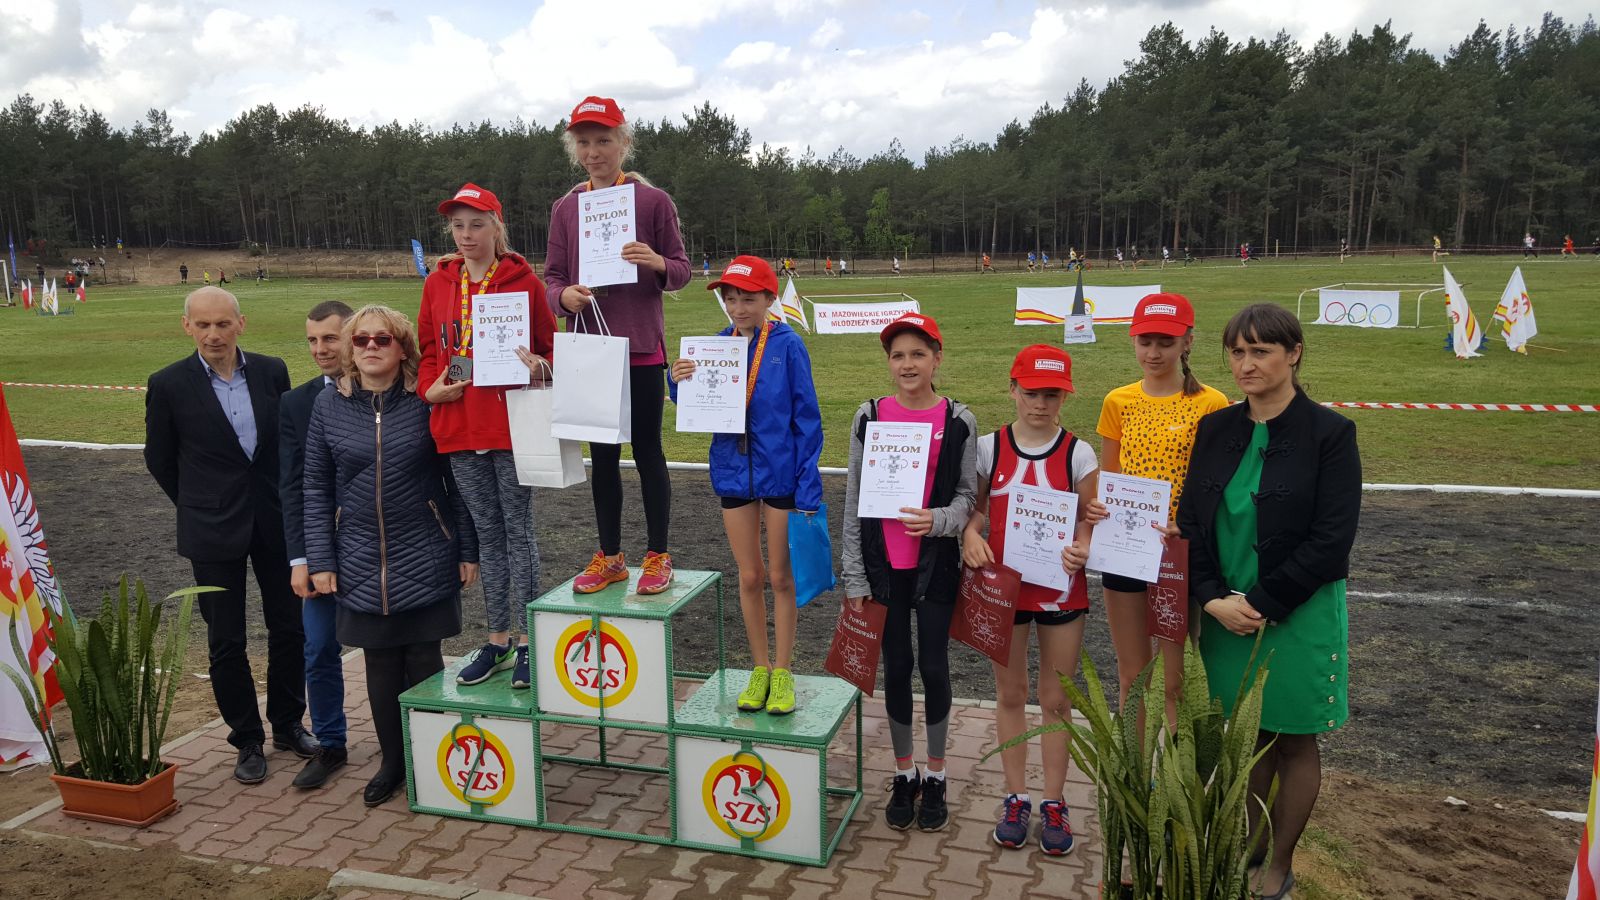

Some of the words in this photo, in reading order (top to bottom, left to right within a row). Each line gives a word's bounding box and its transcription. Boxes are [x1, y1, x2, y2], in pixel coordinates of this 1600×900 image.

[584, 209, 628, 223] DYPLOM
[479, 314, 523, 325] DYPLOM
[831, 309, 880, 318] MAZOWIECKIE
[691, 359, 740, 368] YPLOM
[871, 444, 921, 454] DYPLOM
[1105, 496, 1160, 513] DYPLOM
[1015, 506, 1067, 525] DYPLOM
[574, 667, 620, 690] SZS
[456, 769, 499, 791] SZS
[723, 801, 772, 825] SZS
